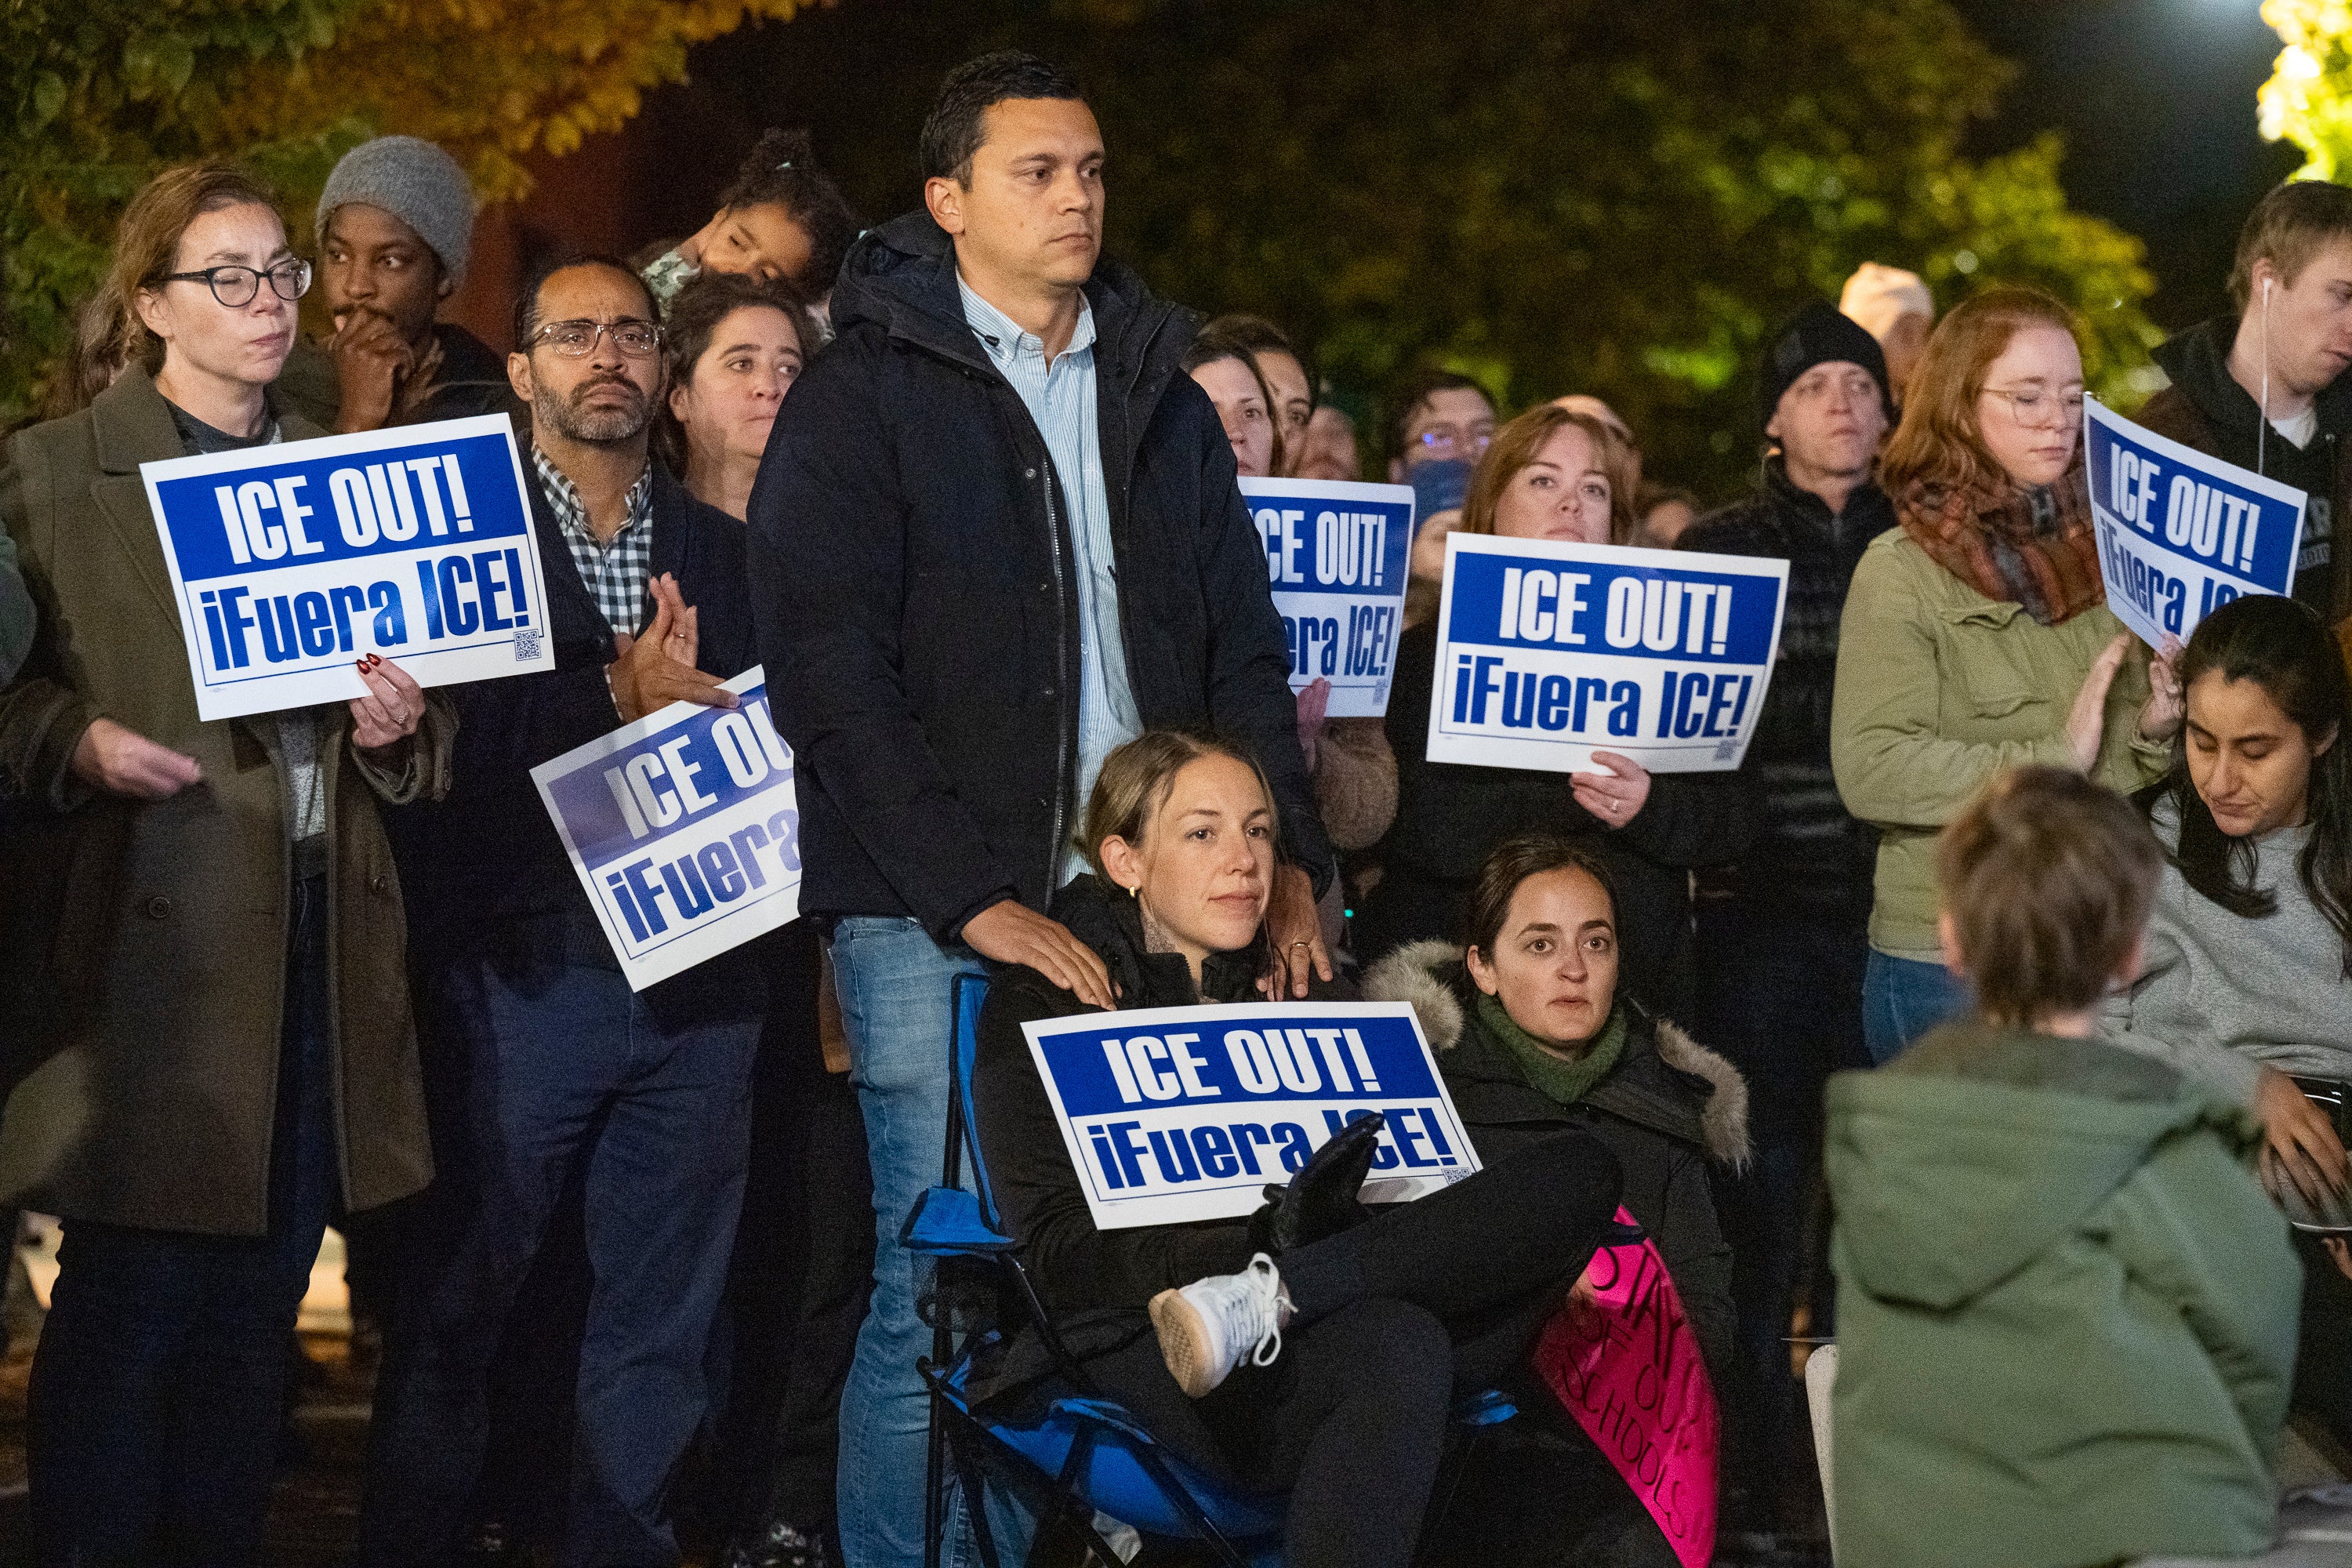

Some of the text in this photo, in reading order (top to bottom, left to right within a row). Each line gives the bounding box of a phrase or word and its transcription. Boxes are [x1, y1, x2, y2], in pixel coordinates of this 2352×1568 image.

[215, 453, 474, 564] ICE OUT!
[1247, 508, 1387, 587] CE OUT!
[2111, 442, 2161, 534] ICE
[2165, 474, 2260, 573] OUT!
[199, 547, 530, 671] ¡Fuera ICE!
[1344, 605, 1396, 677] ICE!
[1499, 567, 1733, 655] ICE OUT!
[1453, 655, 1753, 739] ¡Fuera ICE!
[604, 734, 717, 840] ICE
[1101, 1029, 1381, 1103] ICE OUT!
